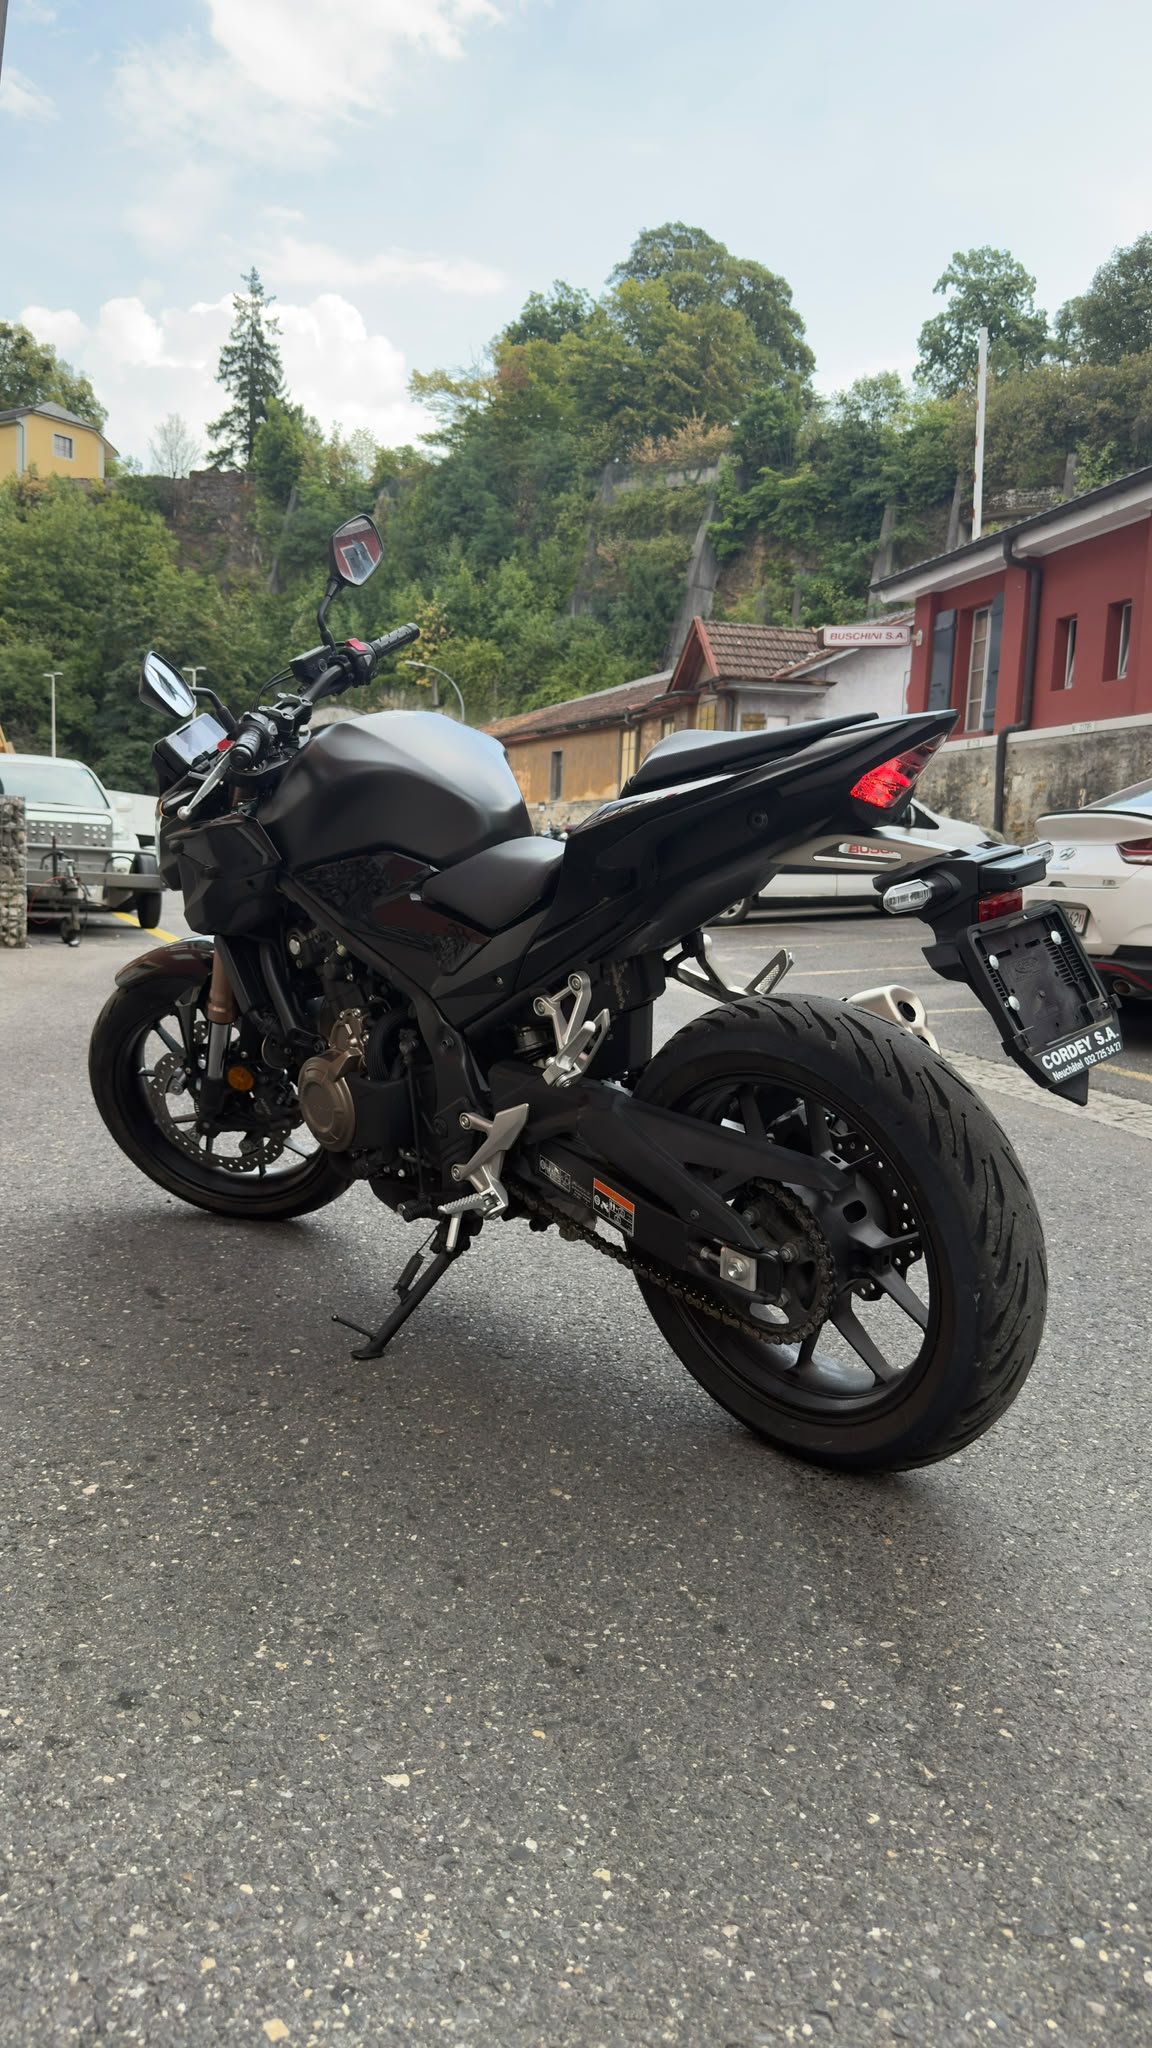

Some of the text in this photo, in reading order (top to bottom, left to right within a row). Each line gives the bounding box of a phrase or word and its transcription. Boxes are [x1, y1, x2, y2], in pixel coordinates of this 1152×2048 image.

[830, 632, 882, 640] BUSCHINI
[1041, 1026, 1119, 1069] CORDEY S.A.
[1052, 1059, 1084, 1081] Neuchâtel
[1084, 1053, 1098, 1065] 032
[1095, 1048, 1108, 1060] 725
[1105, 1044, 1116, 1056] 34
